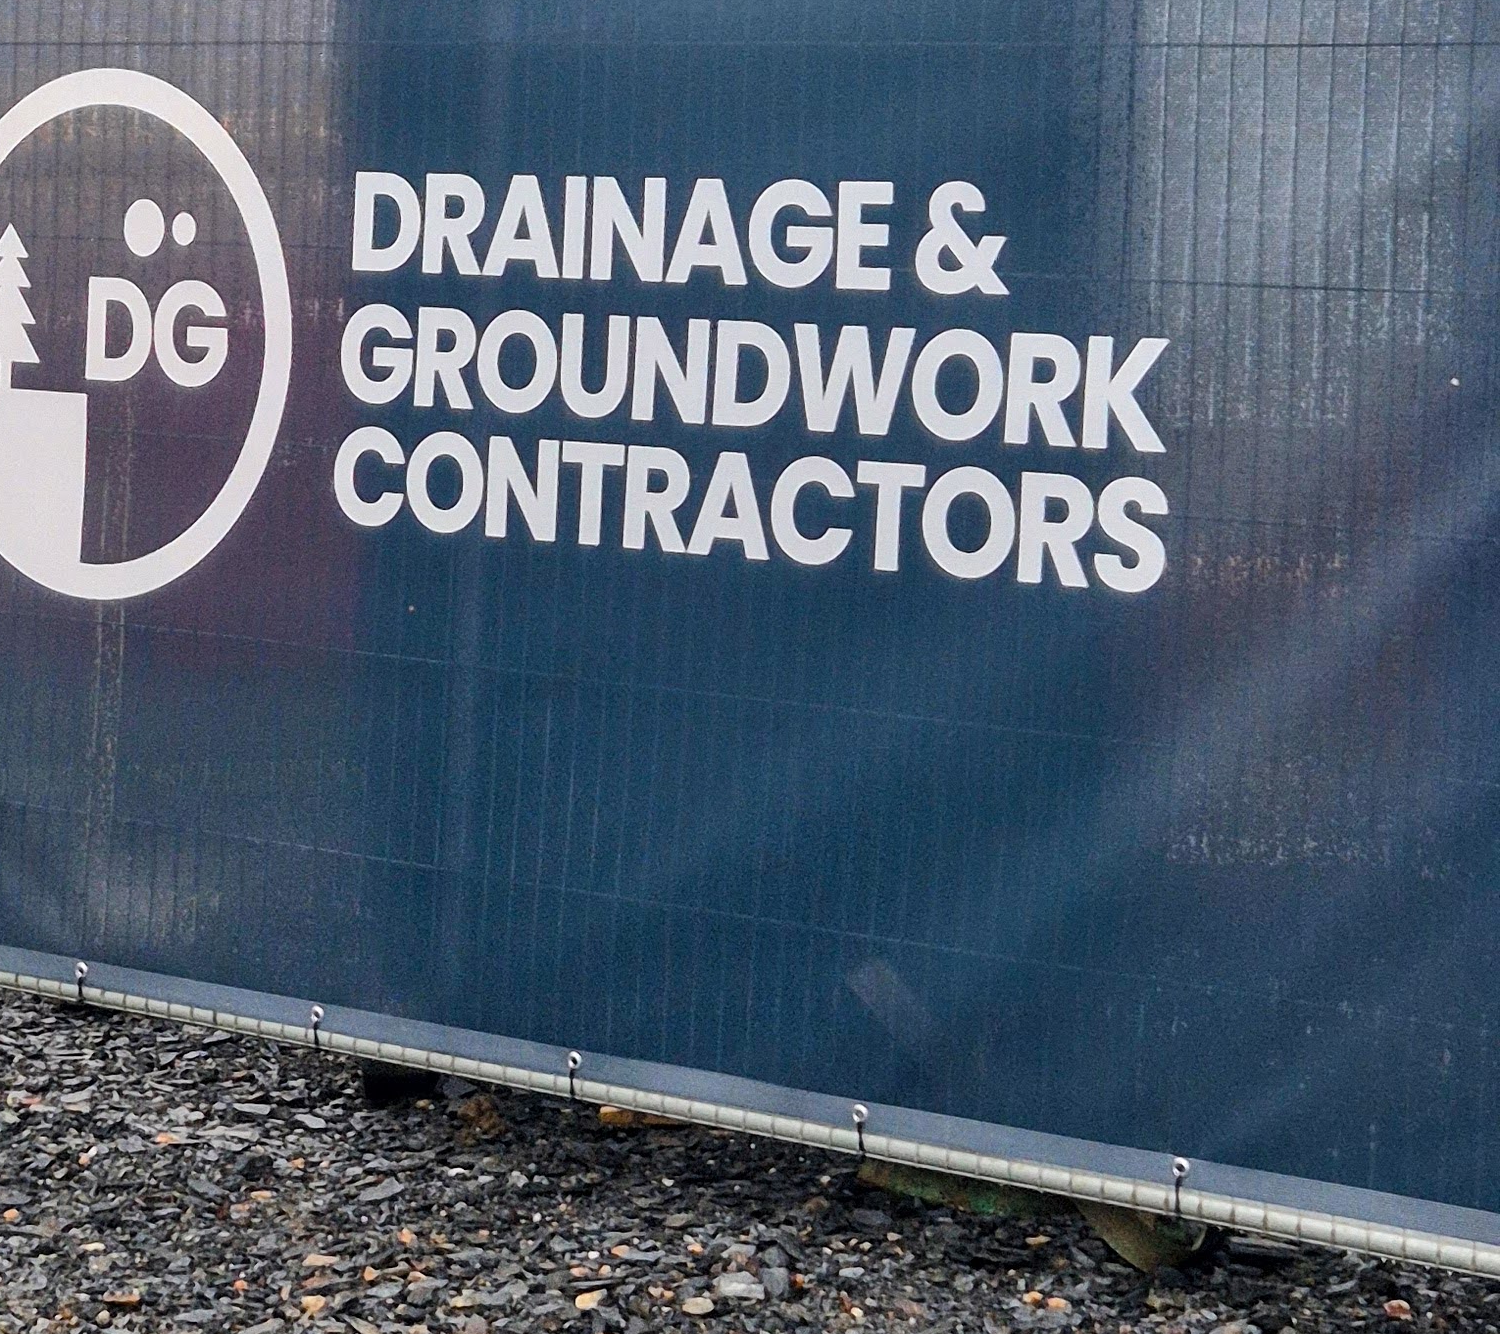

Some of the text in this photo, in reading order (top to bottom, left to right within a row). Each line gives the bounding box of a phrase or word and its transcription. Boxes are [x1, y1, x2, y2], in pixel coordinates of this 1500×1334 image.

[350, 170, 1010, 295] DRAINAGE &
[84, 275, 229, 388] DG
[339, 303, 1171, 453] GROUNDWORK
[332, 426, 1171, 593] CONTRACTORS
